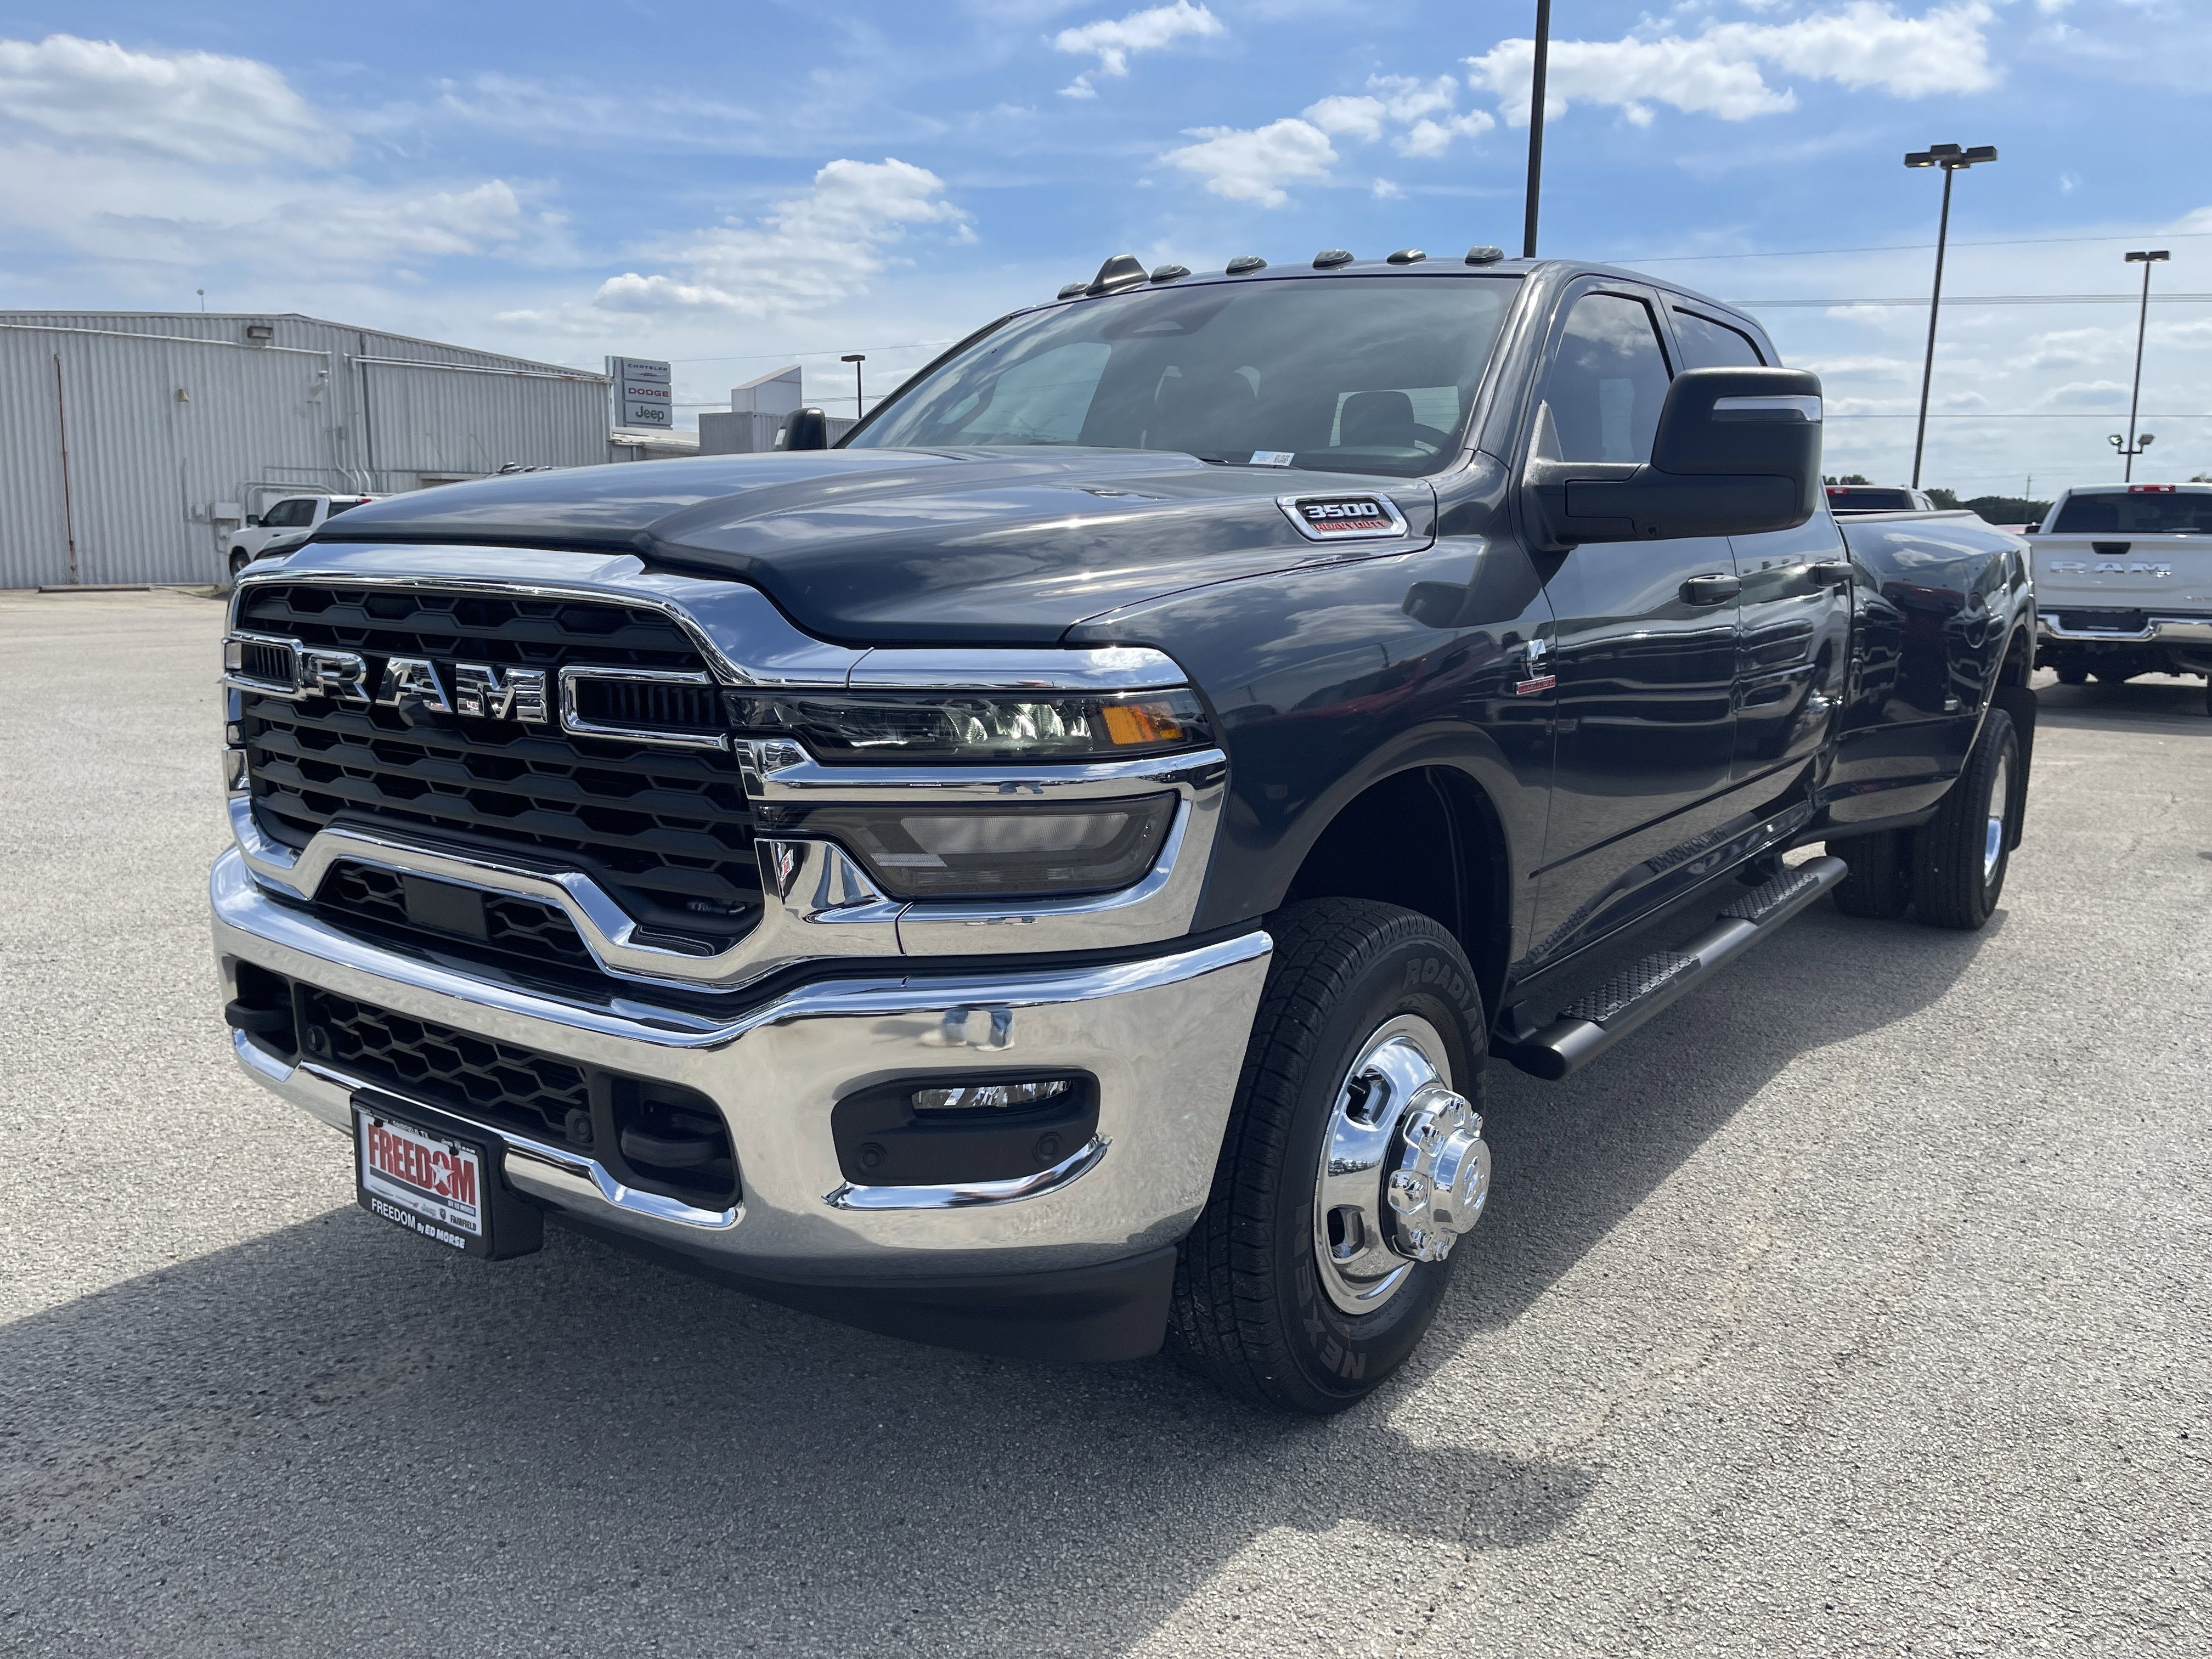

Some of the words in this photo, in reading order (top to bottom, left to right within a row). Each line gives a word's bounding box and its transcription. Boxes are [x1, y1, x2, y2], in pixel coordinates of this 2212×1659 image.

[629, 388, 669, 397] DODGE
[635, 405, 664, 422] Jeep
[1304, 503, 1379, 518] 3500
[1313, 521, 1354, 531] HEAVY
[1353, 519, 1386, 529] DUTY
[2050, 561, 2171, 574] RAM
[301, 647, 548, 724] RAM
[1403, 957, 1484, 1056] ROADIAN
[368, 1123, 476, 1206] FREEDOM
[371, 1198, 416, 1229] FREEDOM
[425, 1224, 436, 1238] ED
[436, 1228, 466, 1249] MORSE
